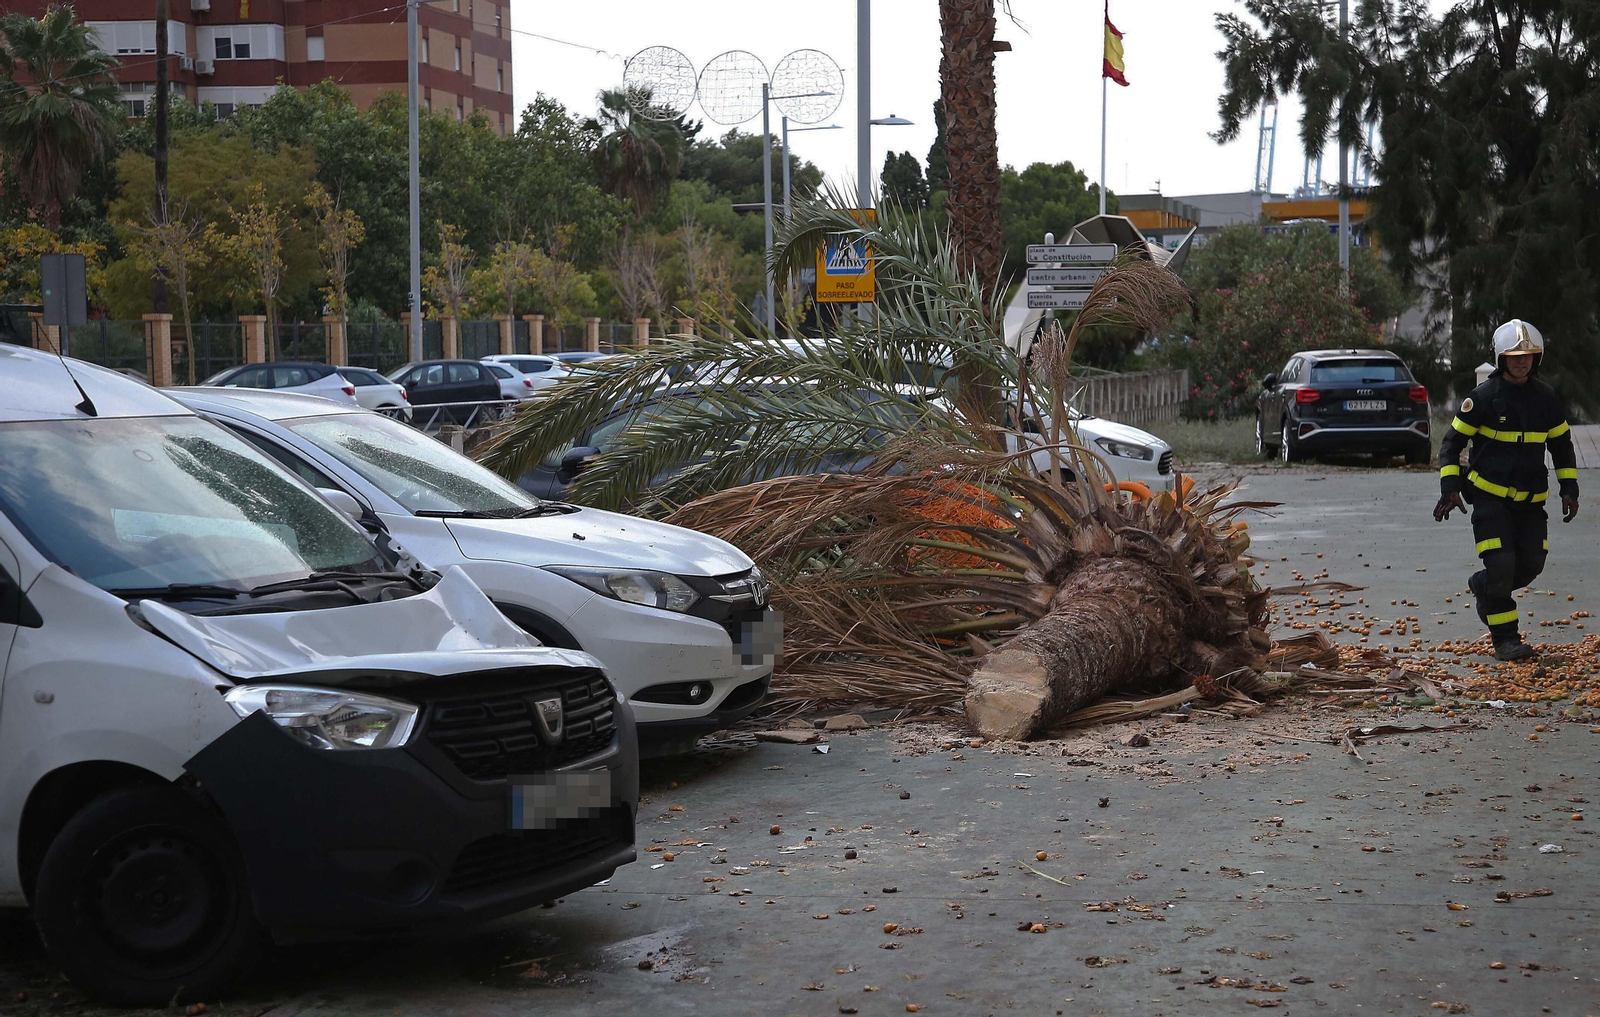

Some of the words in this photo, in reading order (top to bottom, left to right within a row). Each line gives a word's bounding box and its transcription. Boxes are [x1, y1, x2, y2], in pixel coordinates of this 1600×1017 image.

[1042, 253, 1092, 261] Constitución
[1060, 273, 1087, 281] urbano
[818, 290, 873, 298] SOBREELEVADO
